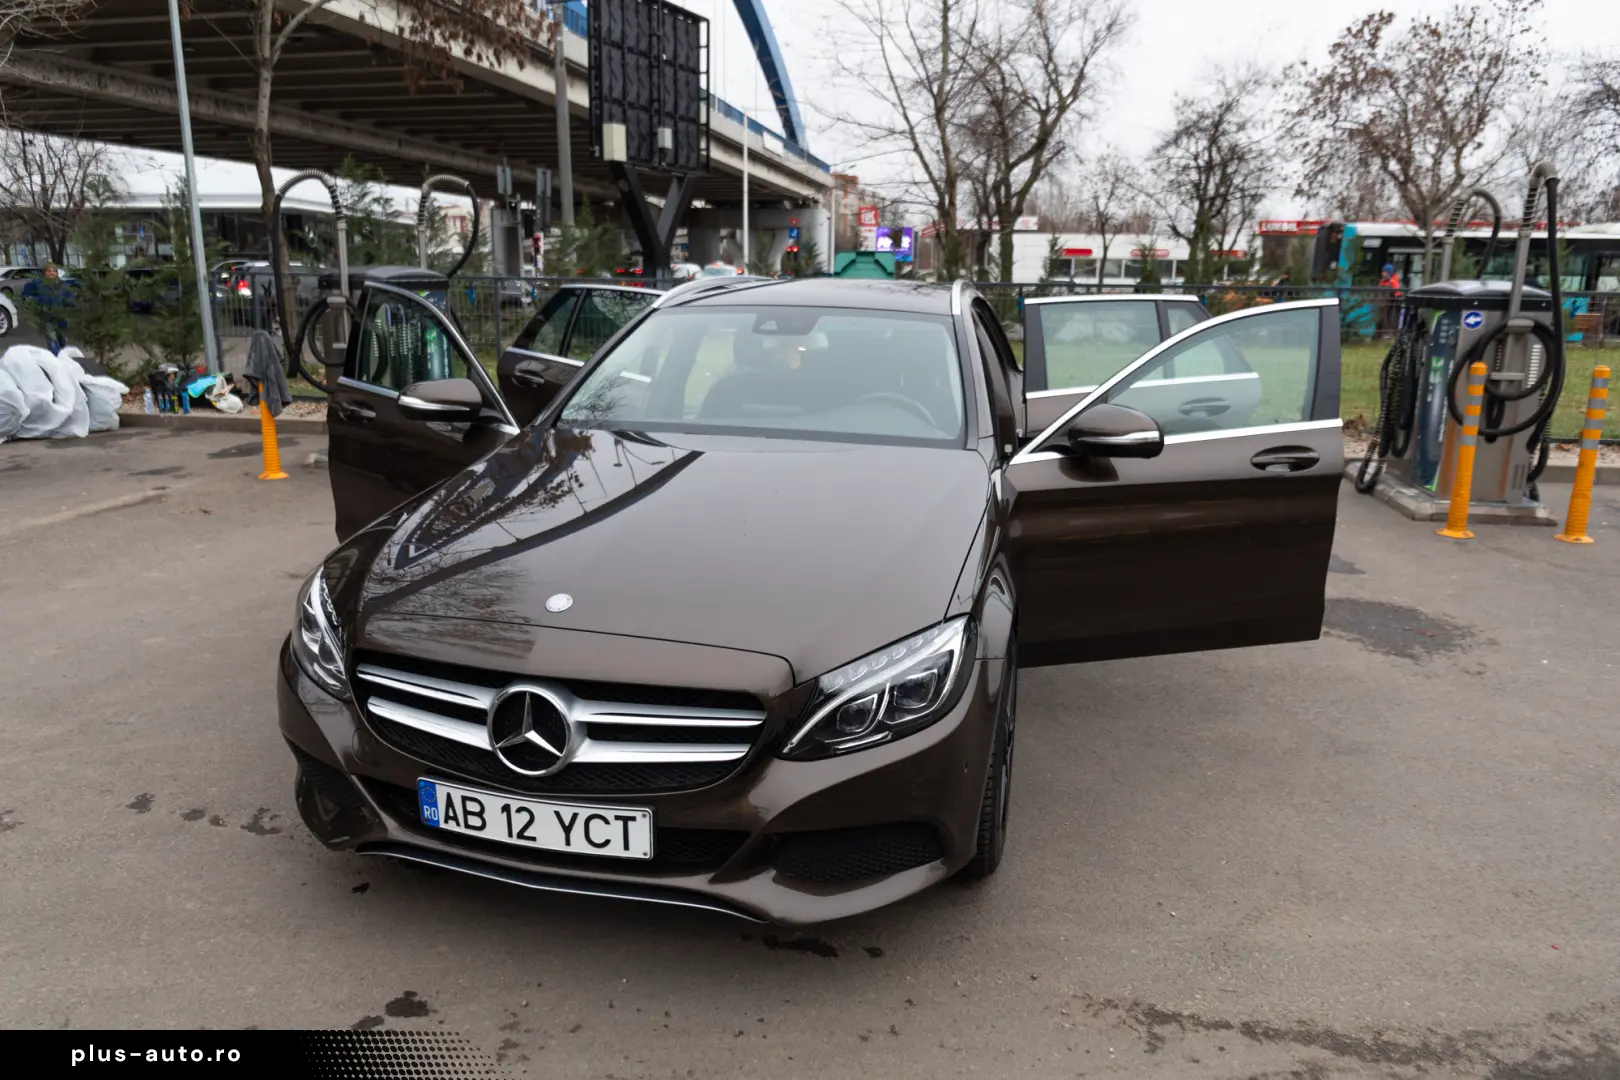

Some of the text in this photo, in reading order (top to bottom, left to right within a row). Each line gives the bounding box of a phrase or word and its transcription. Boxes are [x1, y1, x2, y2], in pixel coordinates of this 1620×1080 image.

[424, 805, 439, 821] RO
[443, 791, 637, 851] AB 12 YCT
